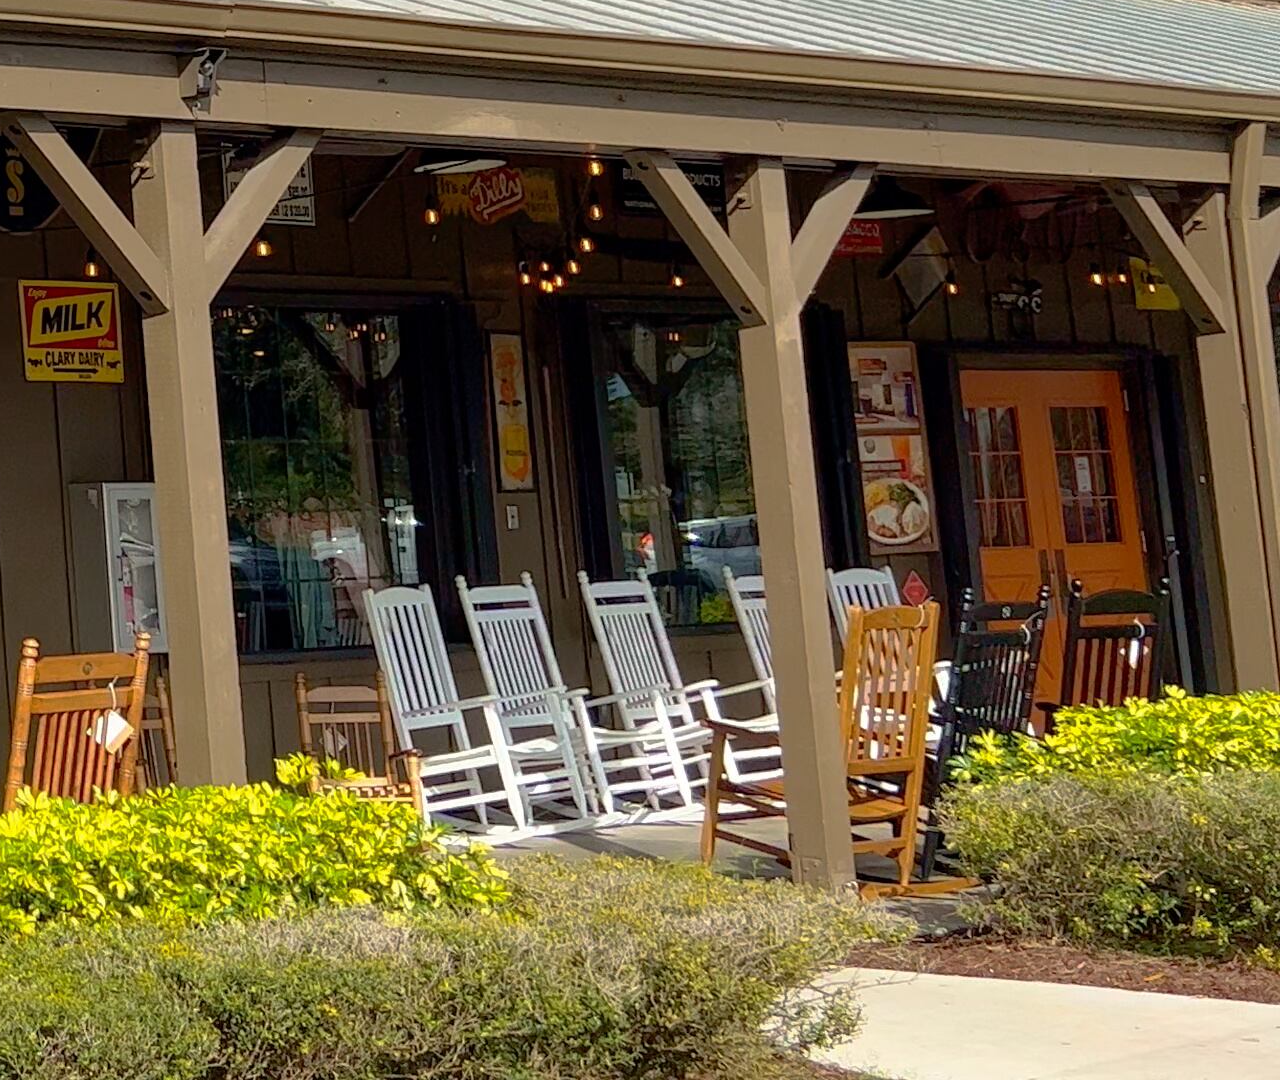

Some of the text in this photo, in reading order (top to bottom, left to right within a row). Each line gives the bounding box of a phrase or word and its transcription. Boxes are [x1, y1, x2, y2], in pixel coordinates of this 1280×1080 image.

[41, 300, 105, 335] MILK
[45, 351, 105, 368] CLARY DAIRY
